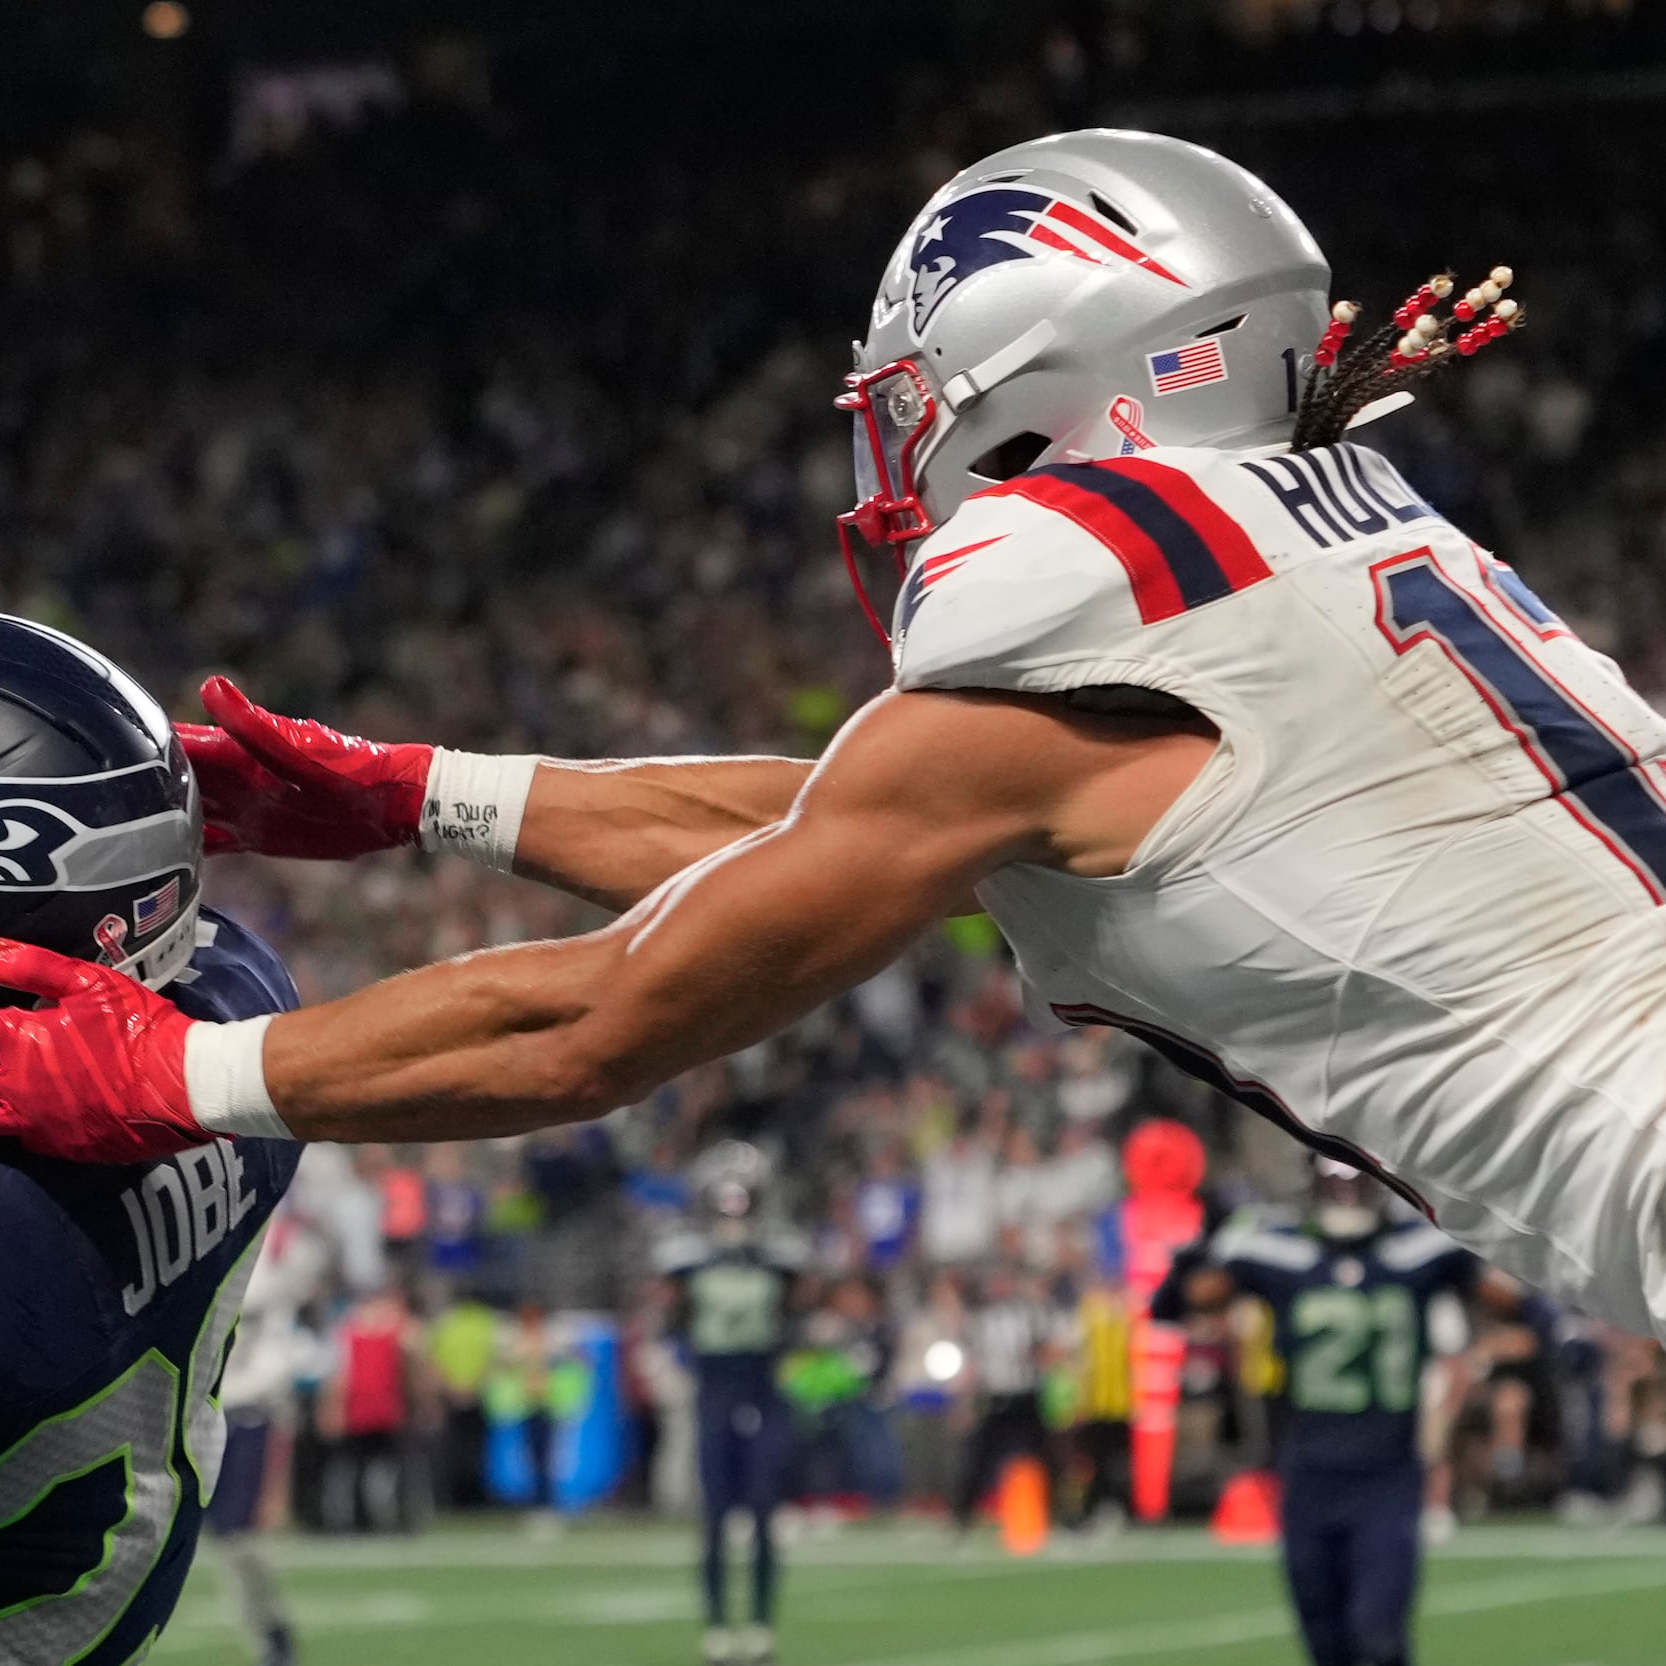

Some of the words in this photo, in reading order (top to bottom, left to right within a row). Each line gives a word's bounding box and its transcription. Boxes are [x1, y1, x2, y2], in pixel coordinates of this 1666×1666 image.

[1237, 441, 1443, 549] HOL
[120, 1136, 257, 1317] JOBE
[1291, 1284, 1416, 1413] 21
